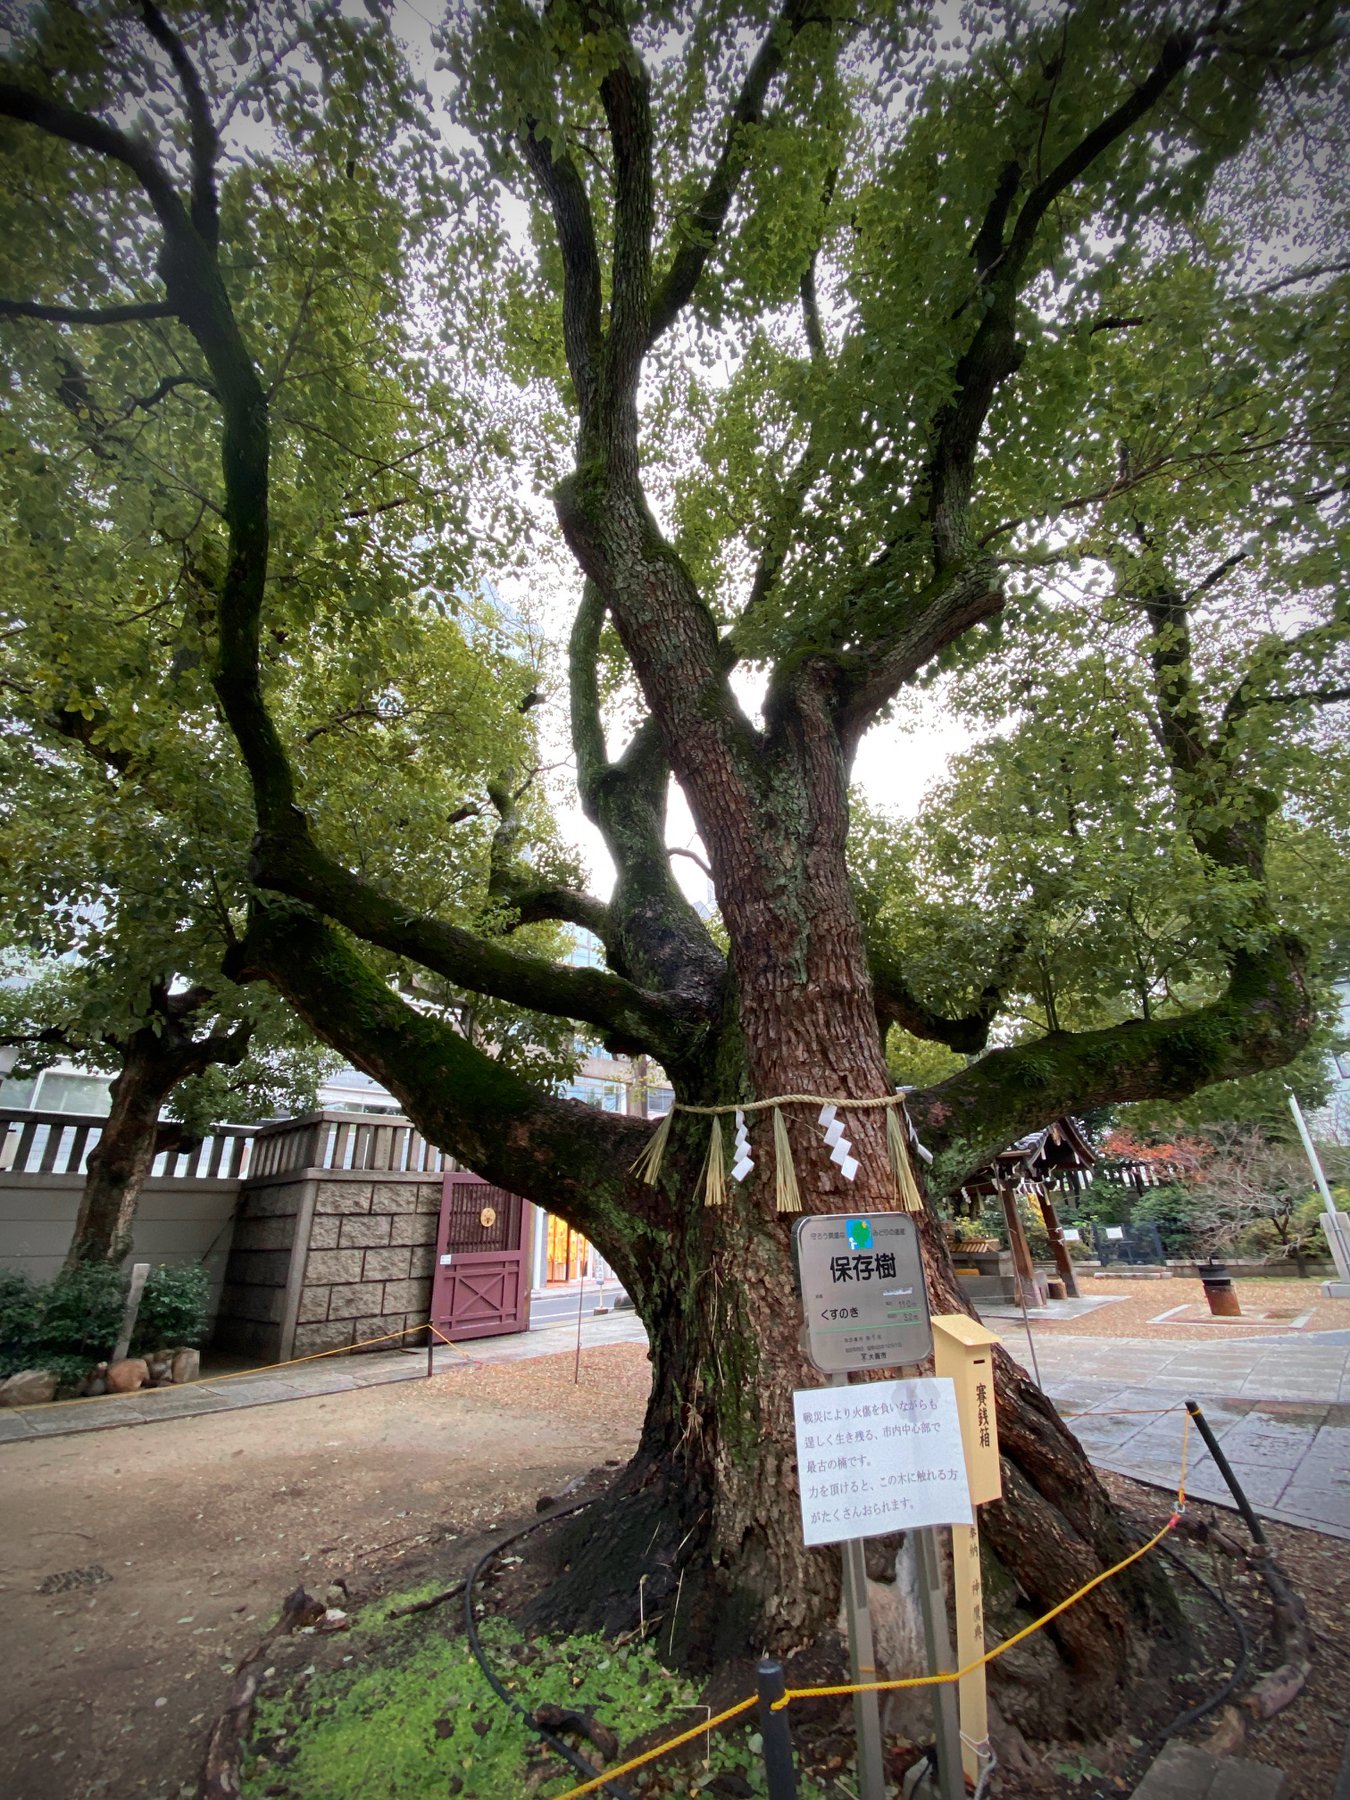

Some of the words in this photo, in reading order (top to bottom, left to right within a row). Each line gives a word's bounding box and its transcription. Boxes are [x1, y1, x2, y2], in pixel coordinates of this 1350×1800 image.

[829, 1252, 897, 1283] 保存樹
[821, 1307, 859, 1321] くすのき
[802, 1399, 938, 1425] 戦災により火傷を負いながらも
[976, 1382, 990, 1448] 賽銭箱
[804, 1421, 942, 1449] 逞しく生き残る、市内中心部で
[807, 1454, 872, 1474] 最古の楠です。
[808, 1467, 959, 1499] 力を頂けると、この木に触れる方
[810, 1497, 915, 1525] がたくさんおられます。
